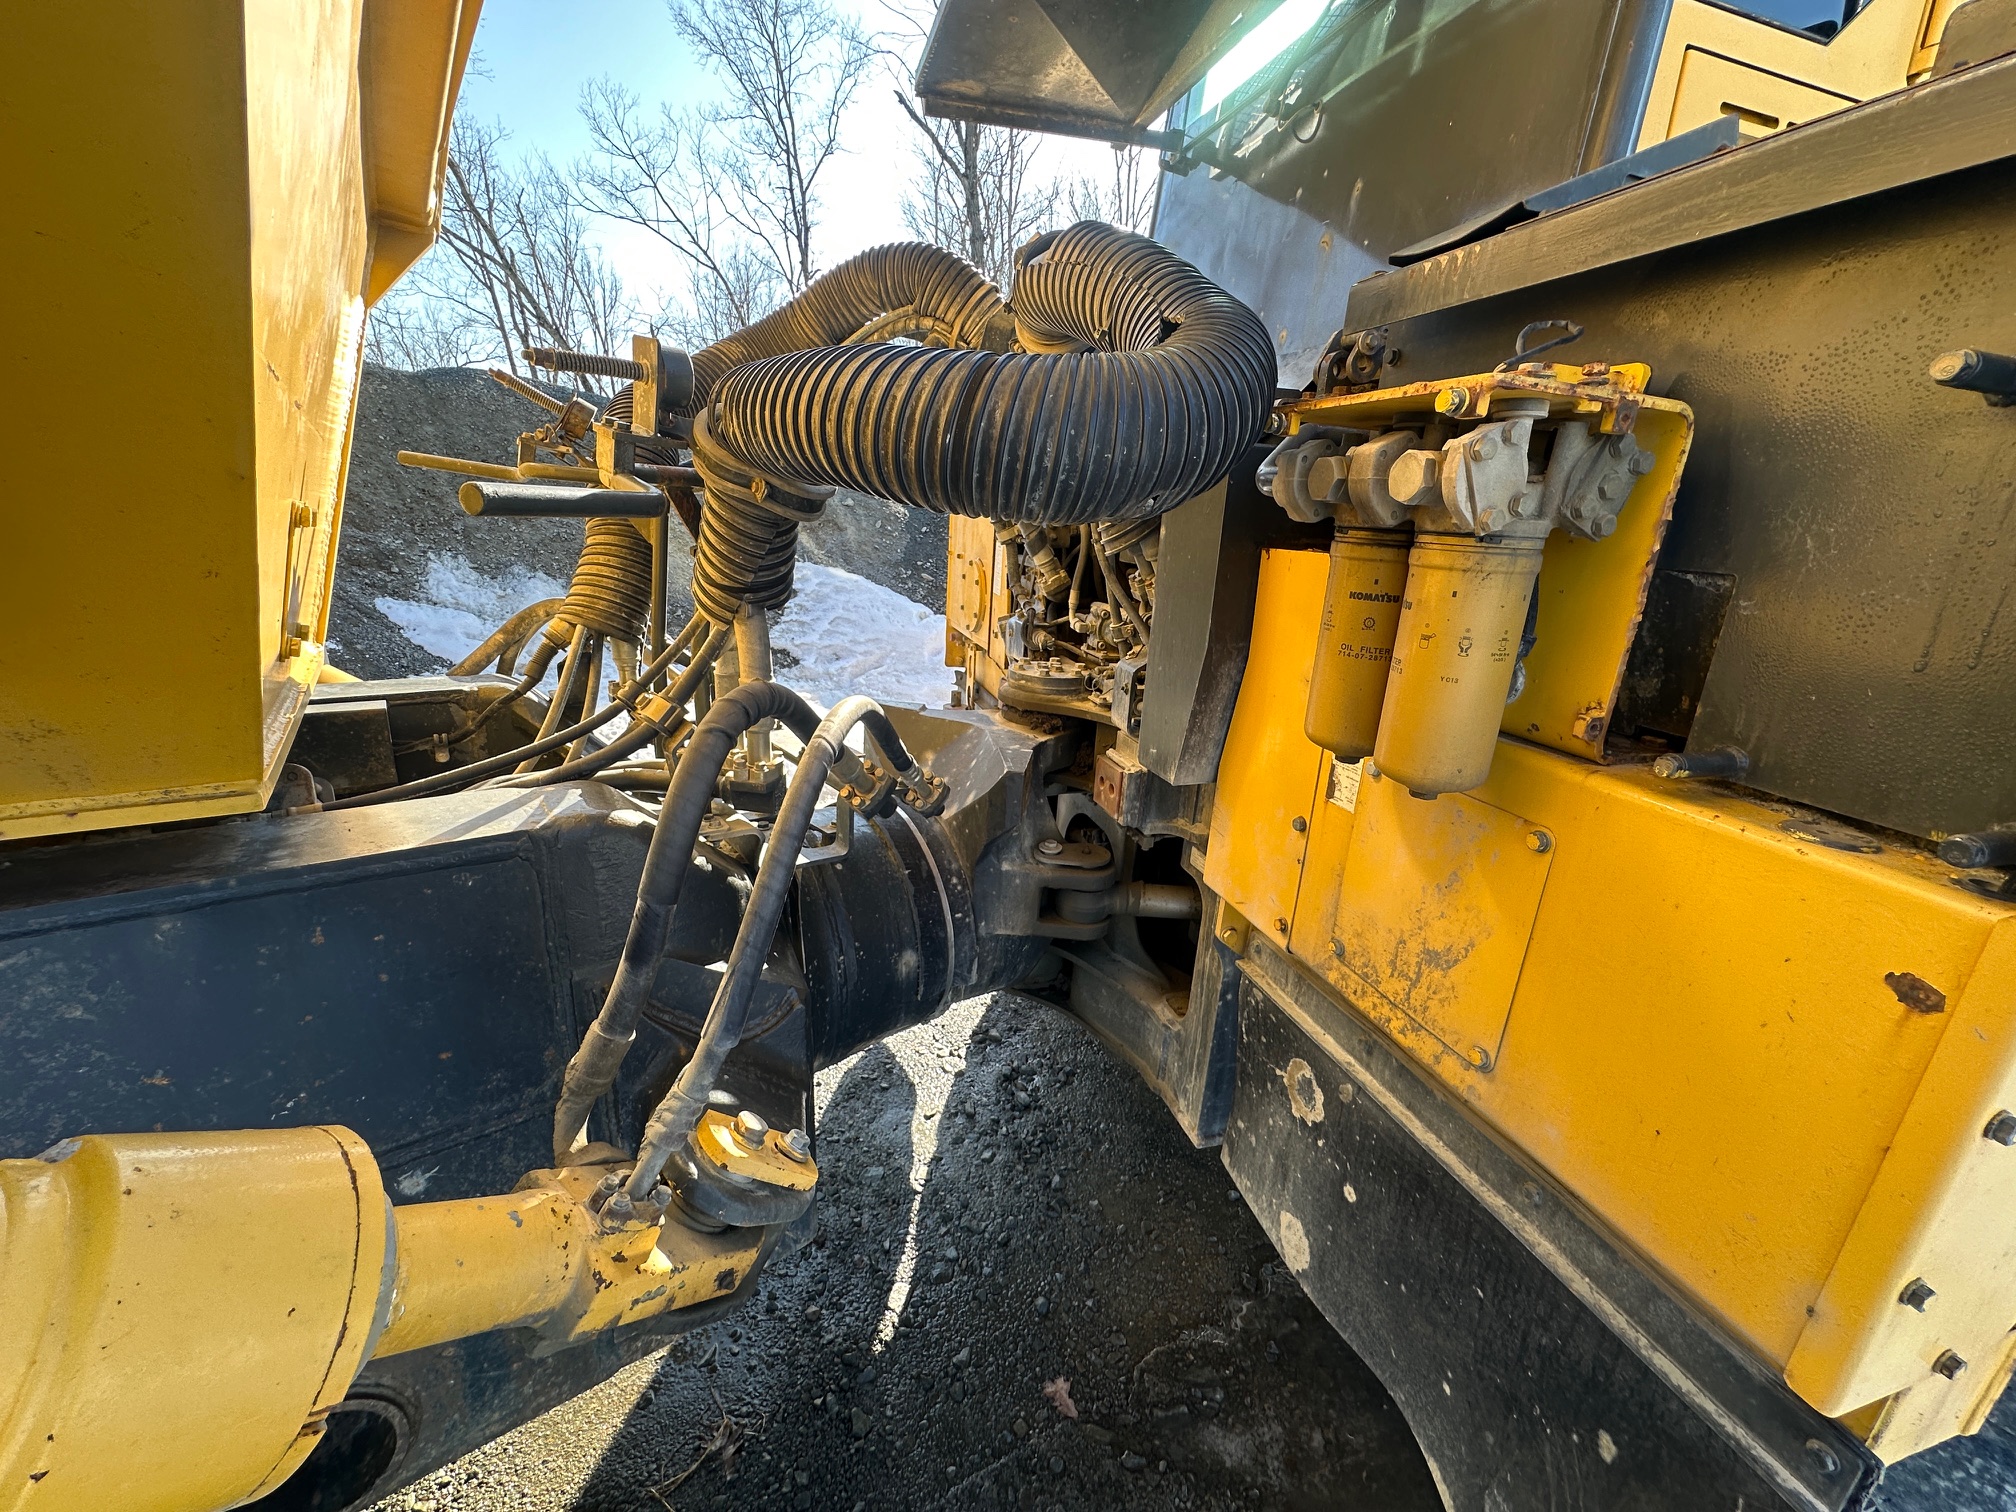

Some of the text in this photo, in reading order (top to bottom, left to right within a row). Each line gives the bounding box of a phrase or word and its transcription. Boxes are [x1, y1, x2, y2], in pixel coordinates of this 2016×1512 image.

[1349, 590, 1400, 603] KOMATSU
[1340, 642, 1391, 656] OIL FILTER
